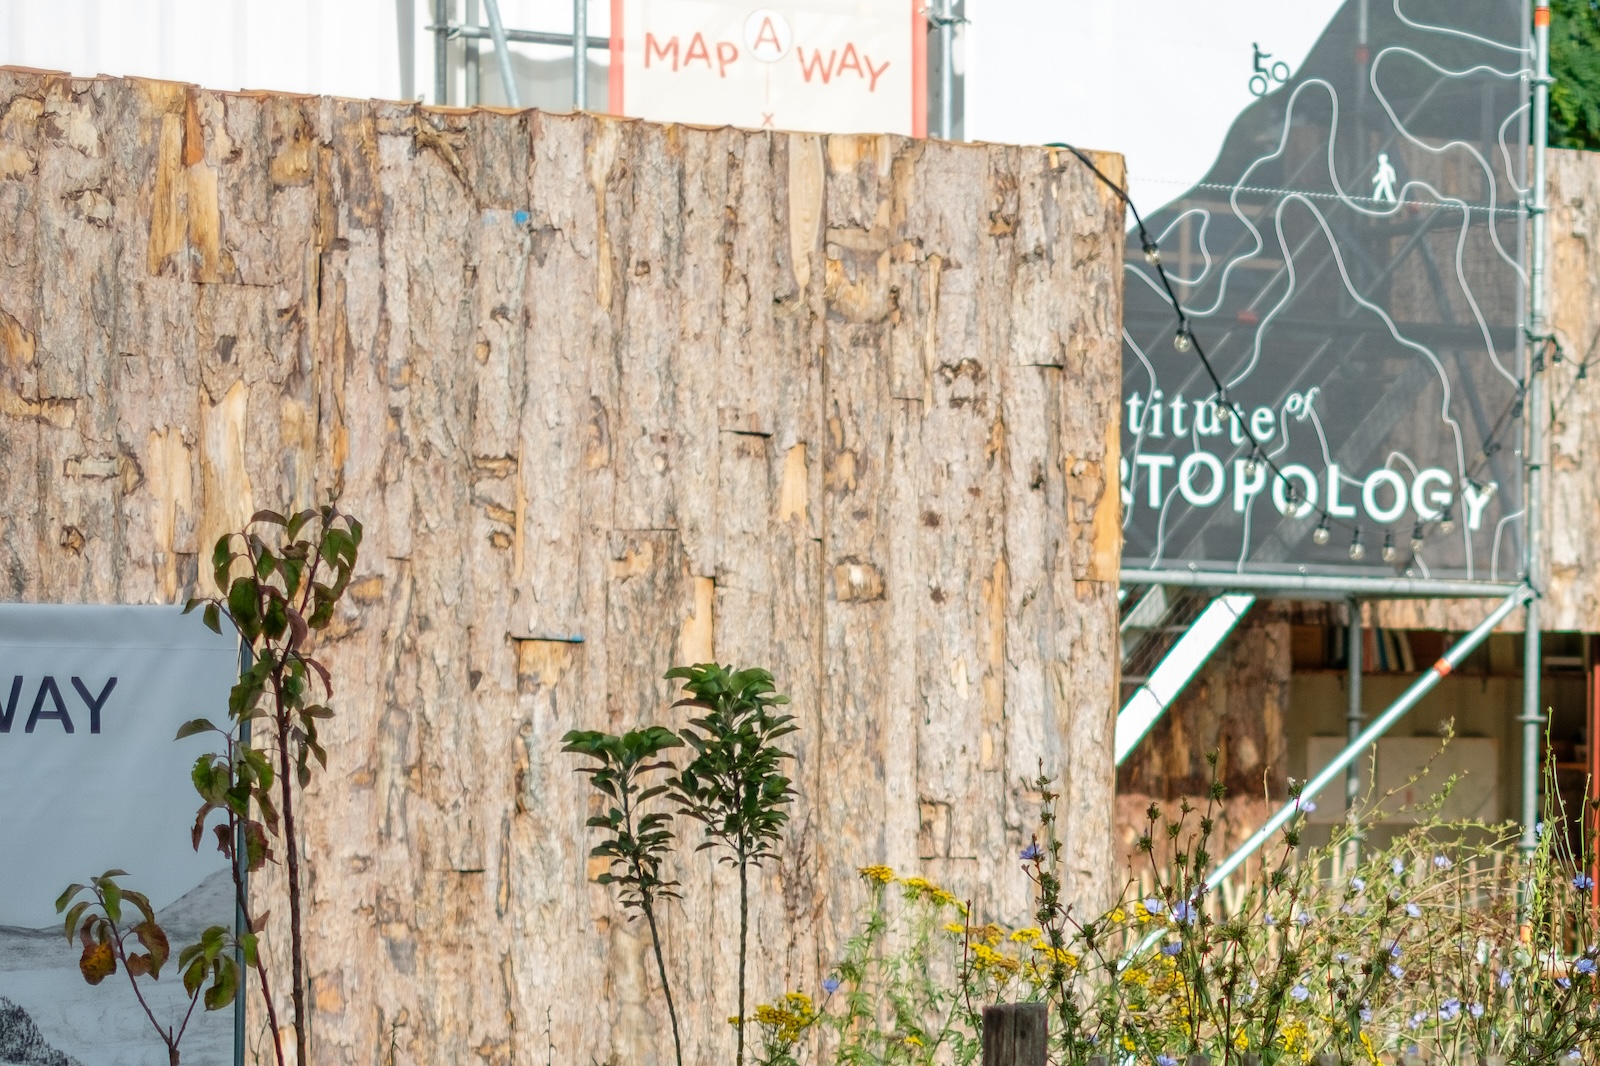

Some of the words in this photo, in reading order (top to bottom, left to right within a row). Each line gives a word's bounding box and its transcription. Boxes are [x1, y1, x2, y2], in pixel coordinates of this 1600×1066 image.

[644, 32, 738, 78] MAP
[754, 16, 781, 52] A
[797, 42, 890, 92] WAY
[1285, 386, 1321, 422] of
